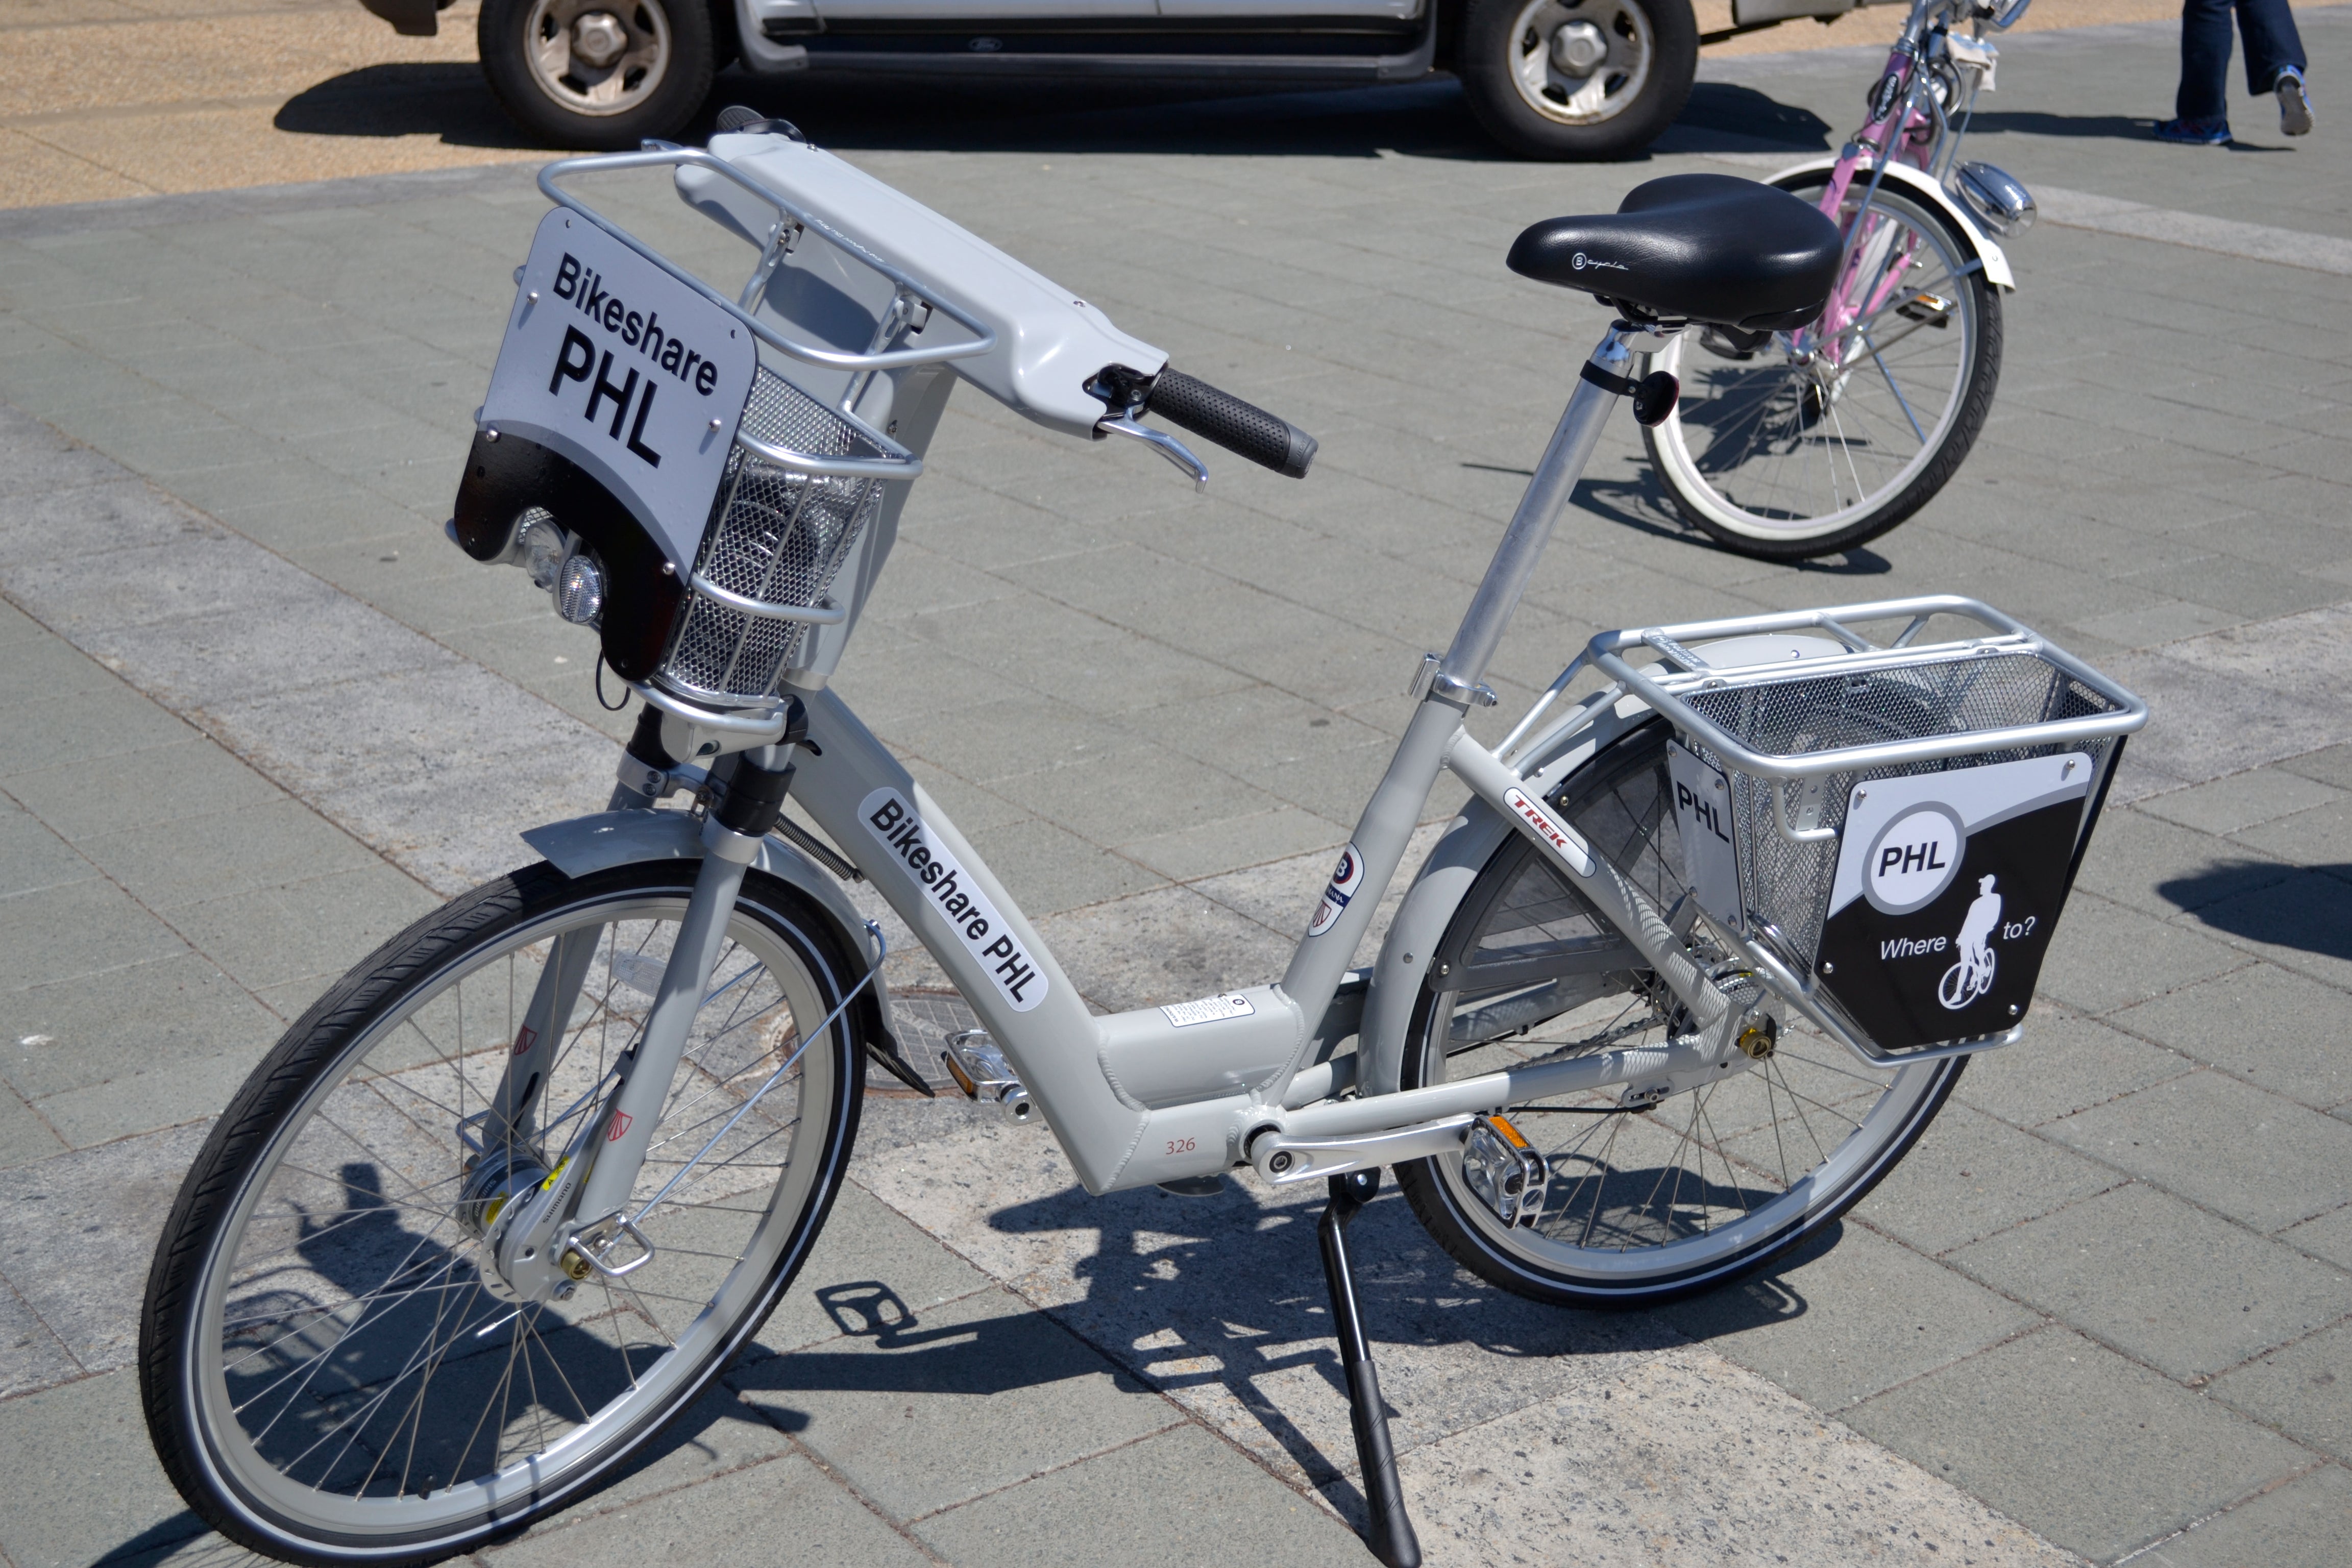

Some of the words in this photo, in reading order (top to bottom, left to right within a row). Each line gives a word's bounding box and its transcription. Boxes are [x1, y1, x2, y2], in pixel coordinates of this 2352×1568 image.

[553, 252, 718, 396] Bikeshare
[549, 324, 662, 469] PHL
[1514, 795, 1567, 848] TREK
[1676, 781, 1730, 844] PHL
[1336, 859, 1349, 877] B
[1878, 840, 1946, 877] PHL
[870, 798, 989, 940] Bikeshare
[982, 934, 1036, 1003] PHL
[1880, 935, 1946, 960] Where
[2003, 916, 2036, 941] to?
[1166, 1137, 1195, 1155] 326
[543, 1182, 571, 1224] SHIMANO
